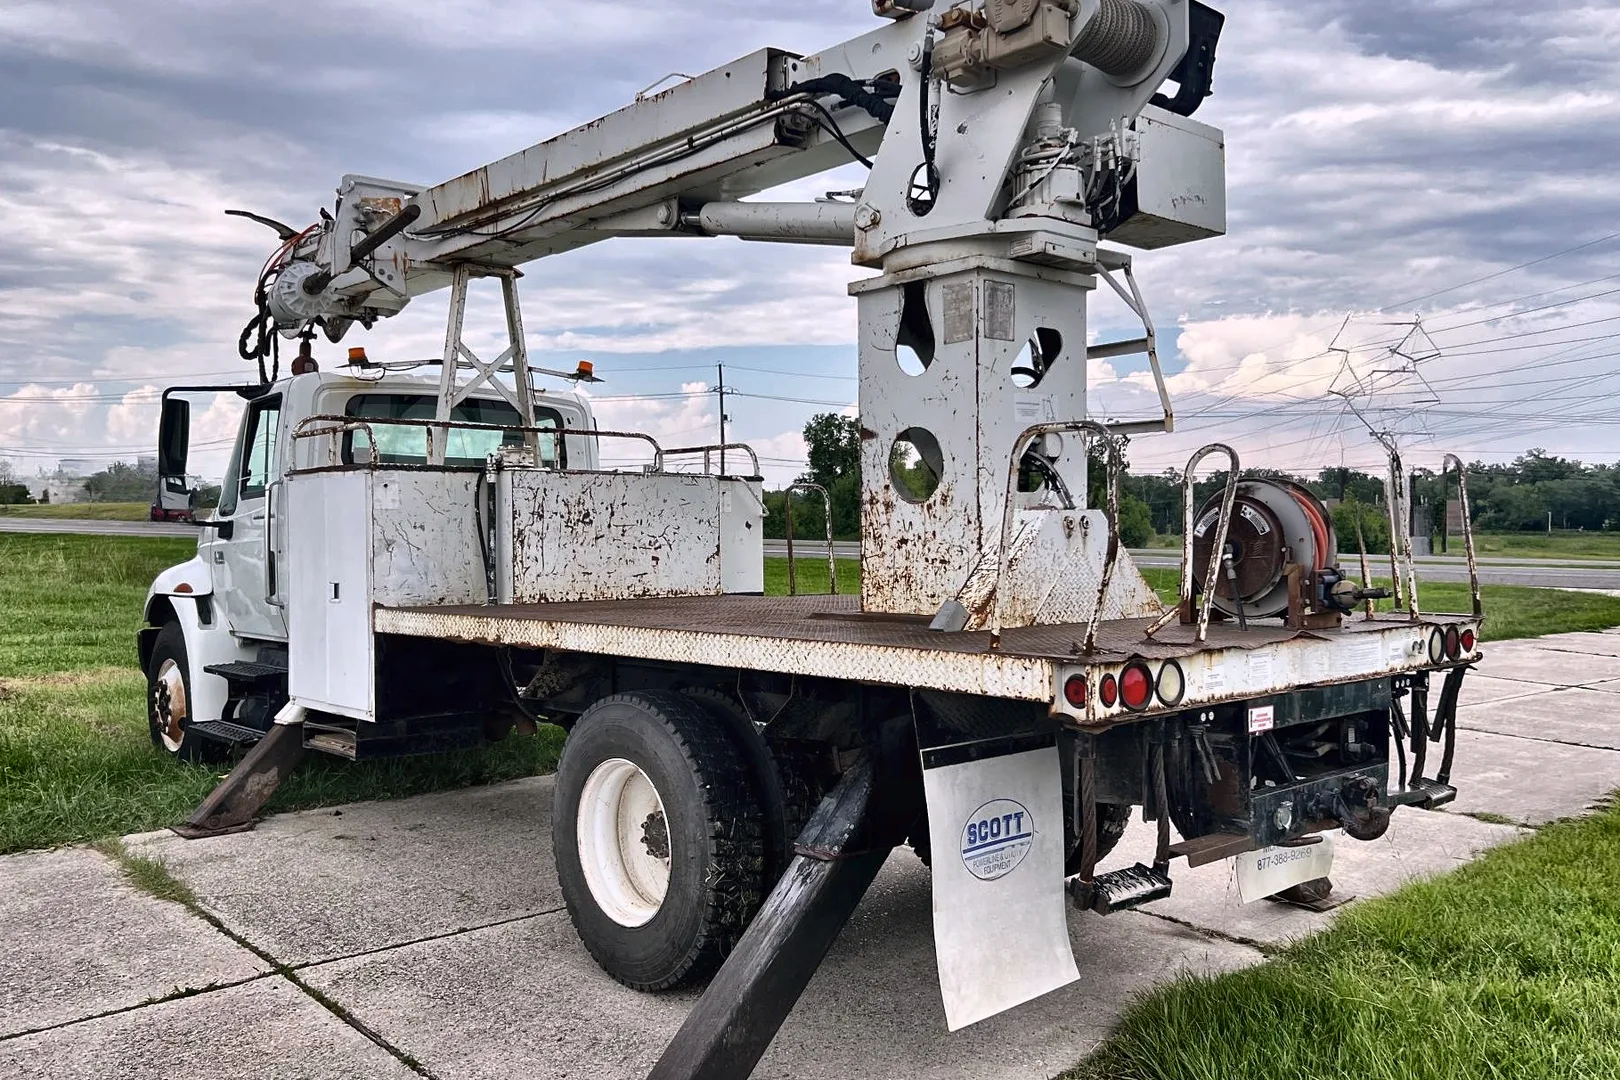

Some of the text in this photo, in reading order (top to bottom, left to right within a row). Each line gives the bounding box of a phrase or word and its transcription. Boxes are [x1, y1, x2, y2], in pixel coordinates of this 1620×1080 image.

[967, 811, 1024, 845] SCOTT
[983, 860, 1011, 874] EQUIPMENT
[1257, 847, 1312, 871] 877-388-9269
